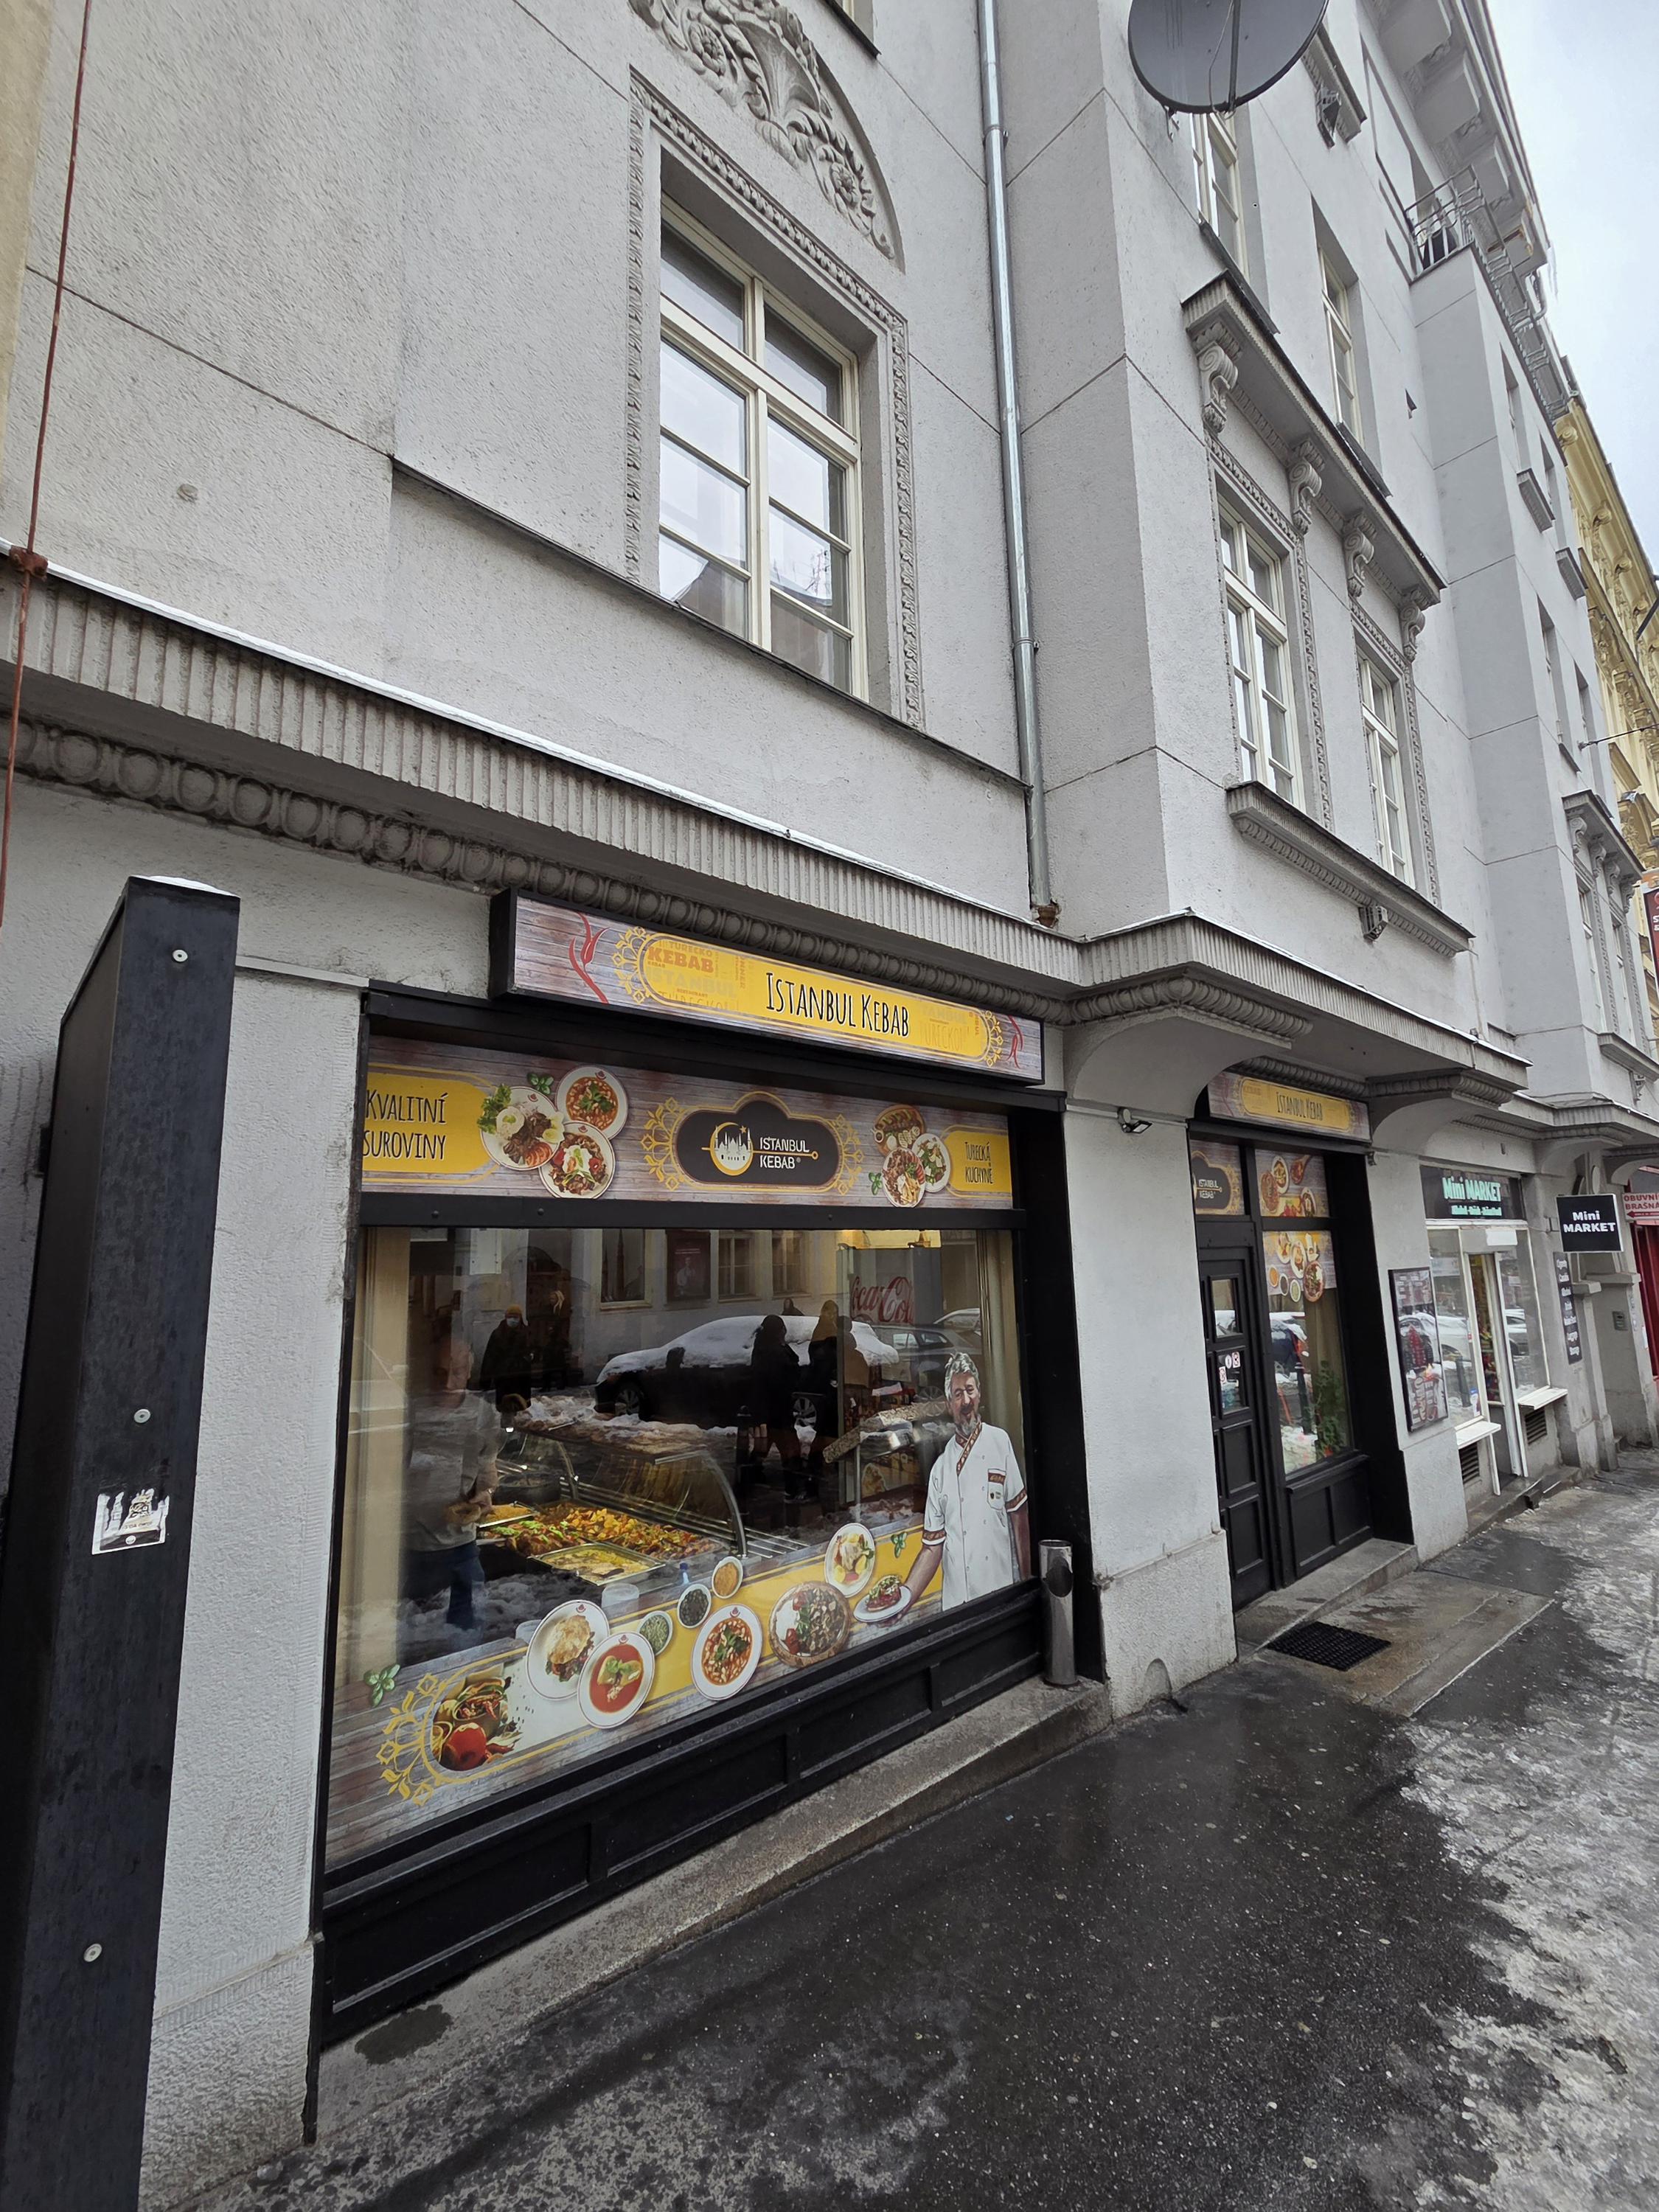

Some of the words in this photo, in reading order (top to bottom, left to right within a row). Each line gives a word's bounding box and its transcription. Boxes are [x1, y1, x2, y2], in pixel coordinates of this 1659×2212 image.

[646, 946, 714, 974] KEBAB
[861, 994, 910, 1037] KEBAB
[366, 1089, 449, 1124] KVALITNÍ
[362, 1130, 447, 1160] SUROVINY
[759, 1136, 810, 1153] ISTANBUL
[1441, 1175, 1466, 1200] Mini
[1465, 1179, 1501, 1202] MARKET
[1562, 1222, 1616, 1233] MARKET
[1572, 1210, 1601, 1221] Mini
